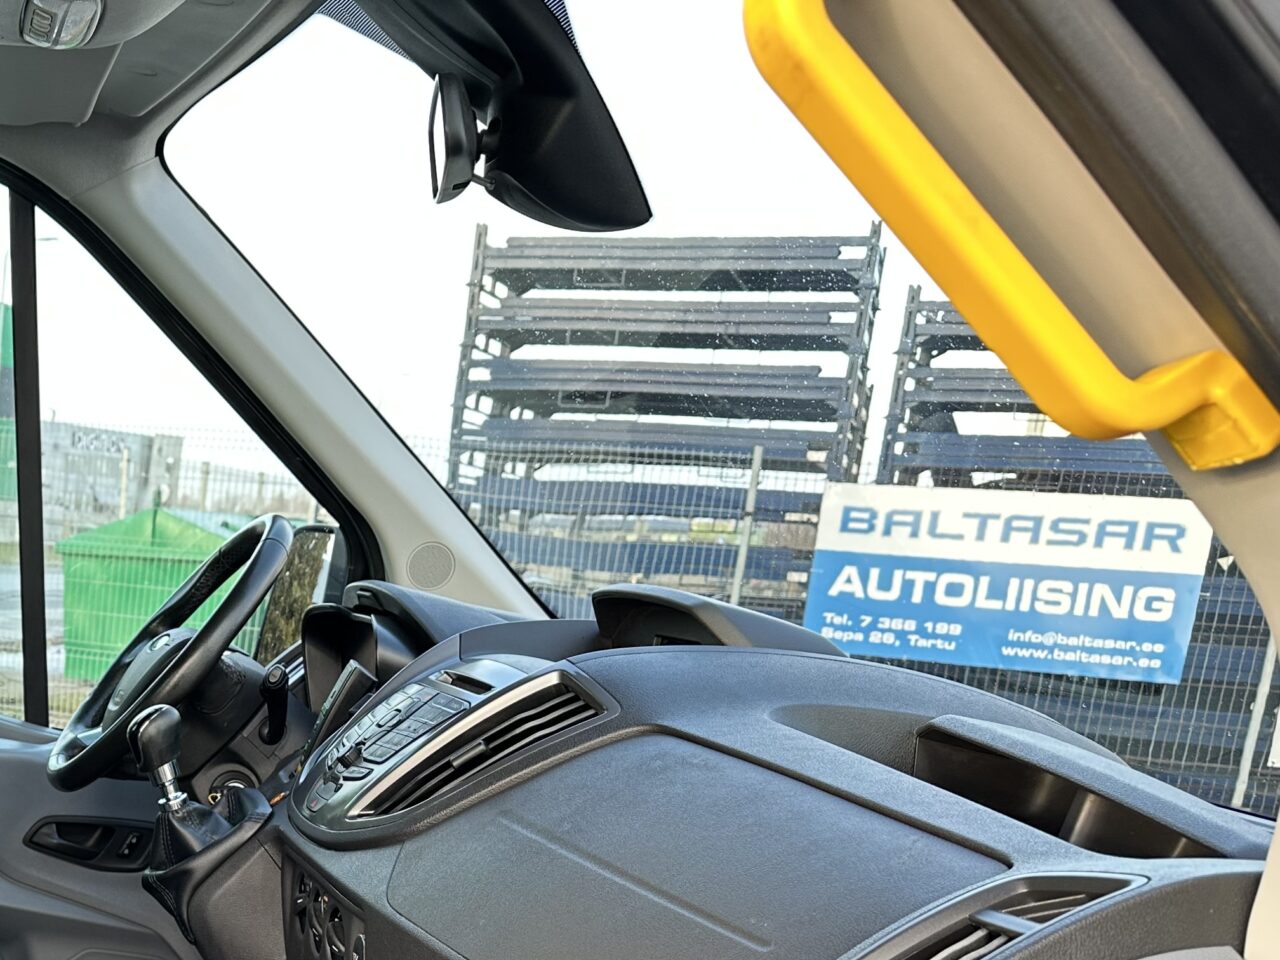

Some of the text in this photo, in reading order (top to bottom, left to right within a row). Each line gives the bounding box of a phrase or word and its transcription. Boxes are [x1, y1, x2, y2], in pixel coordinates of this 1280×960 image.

[839, 505, 1187, 554] BALTASAR
[828, 565, 1177, 623] AUTOLIISING
[823, 612, 853, 626] Tel.
[859, 615, 872, 627] 7
[907, 633, 956, 650] Tartu
[1008, 629, 1165, 653] info@baltasar.ee
[1001, 646, 1162, 669] www.baltasar.ee
